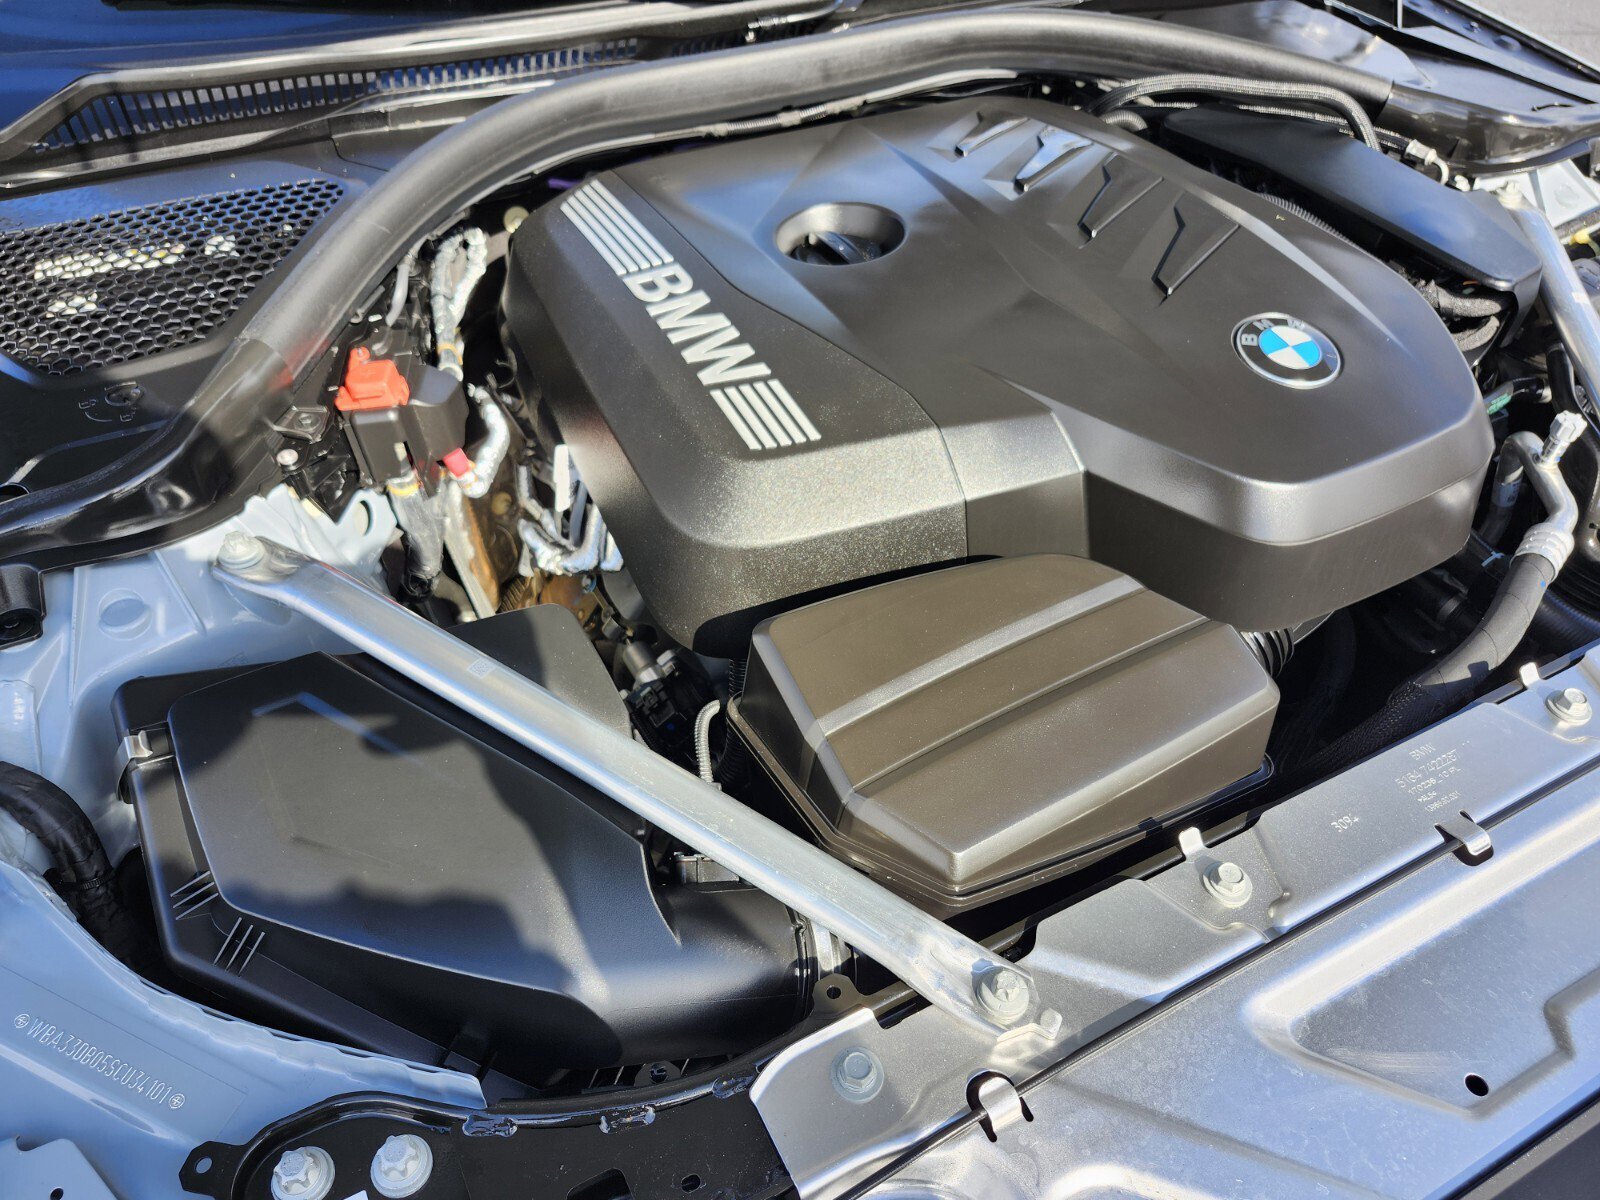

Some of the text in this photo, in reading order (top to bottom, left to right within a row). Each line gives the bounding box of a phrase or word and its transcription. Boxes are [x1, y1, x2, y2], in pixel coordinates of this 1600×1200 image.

[622, 262, 772, 386] BMW
[1241, 319, 1306, 347] BMW
[1409, 742, 1436, 761] BMW
[27, 1017, 173, 1105] WBA33DB05SCU34101
